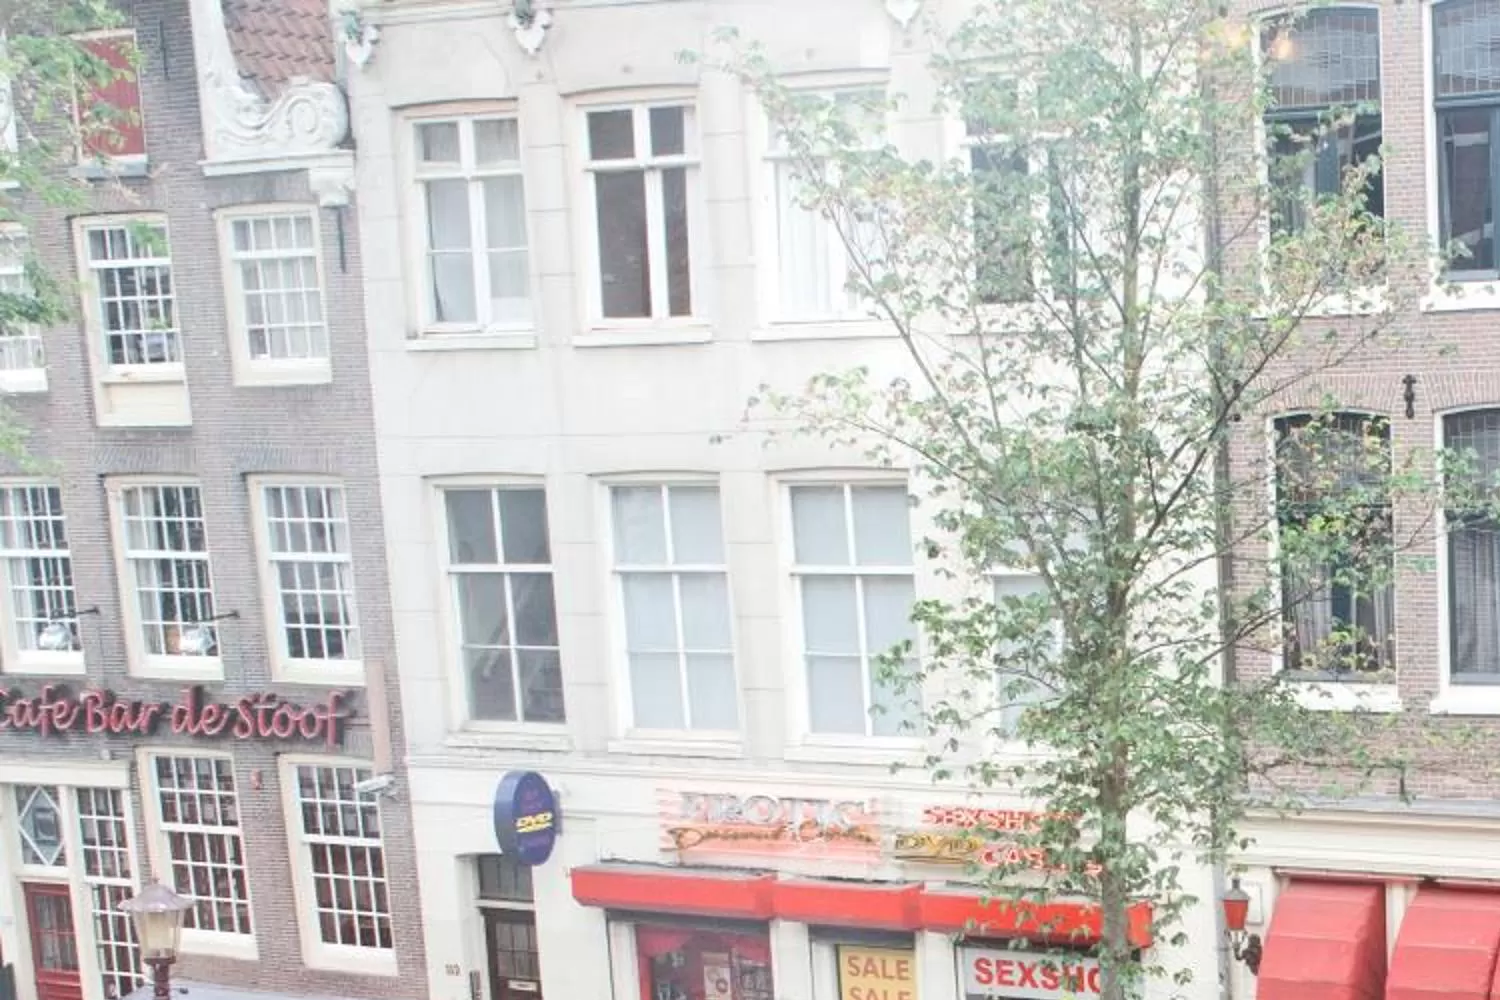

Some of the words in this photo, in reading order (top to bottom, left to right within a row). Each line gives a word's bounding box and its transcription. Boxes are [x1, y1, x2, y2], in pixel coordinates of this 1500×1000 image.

[80, 690, 160, 732] Bar
[171, 688, 230, 735] de
[231, 690, 347, 747] Stoof
[847, 955, 911, 981] SALE
[974, 957, 1100, 993] SEXSHO
